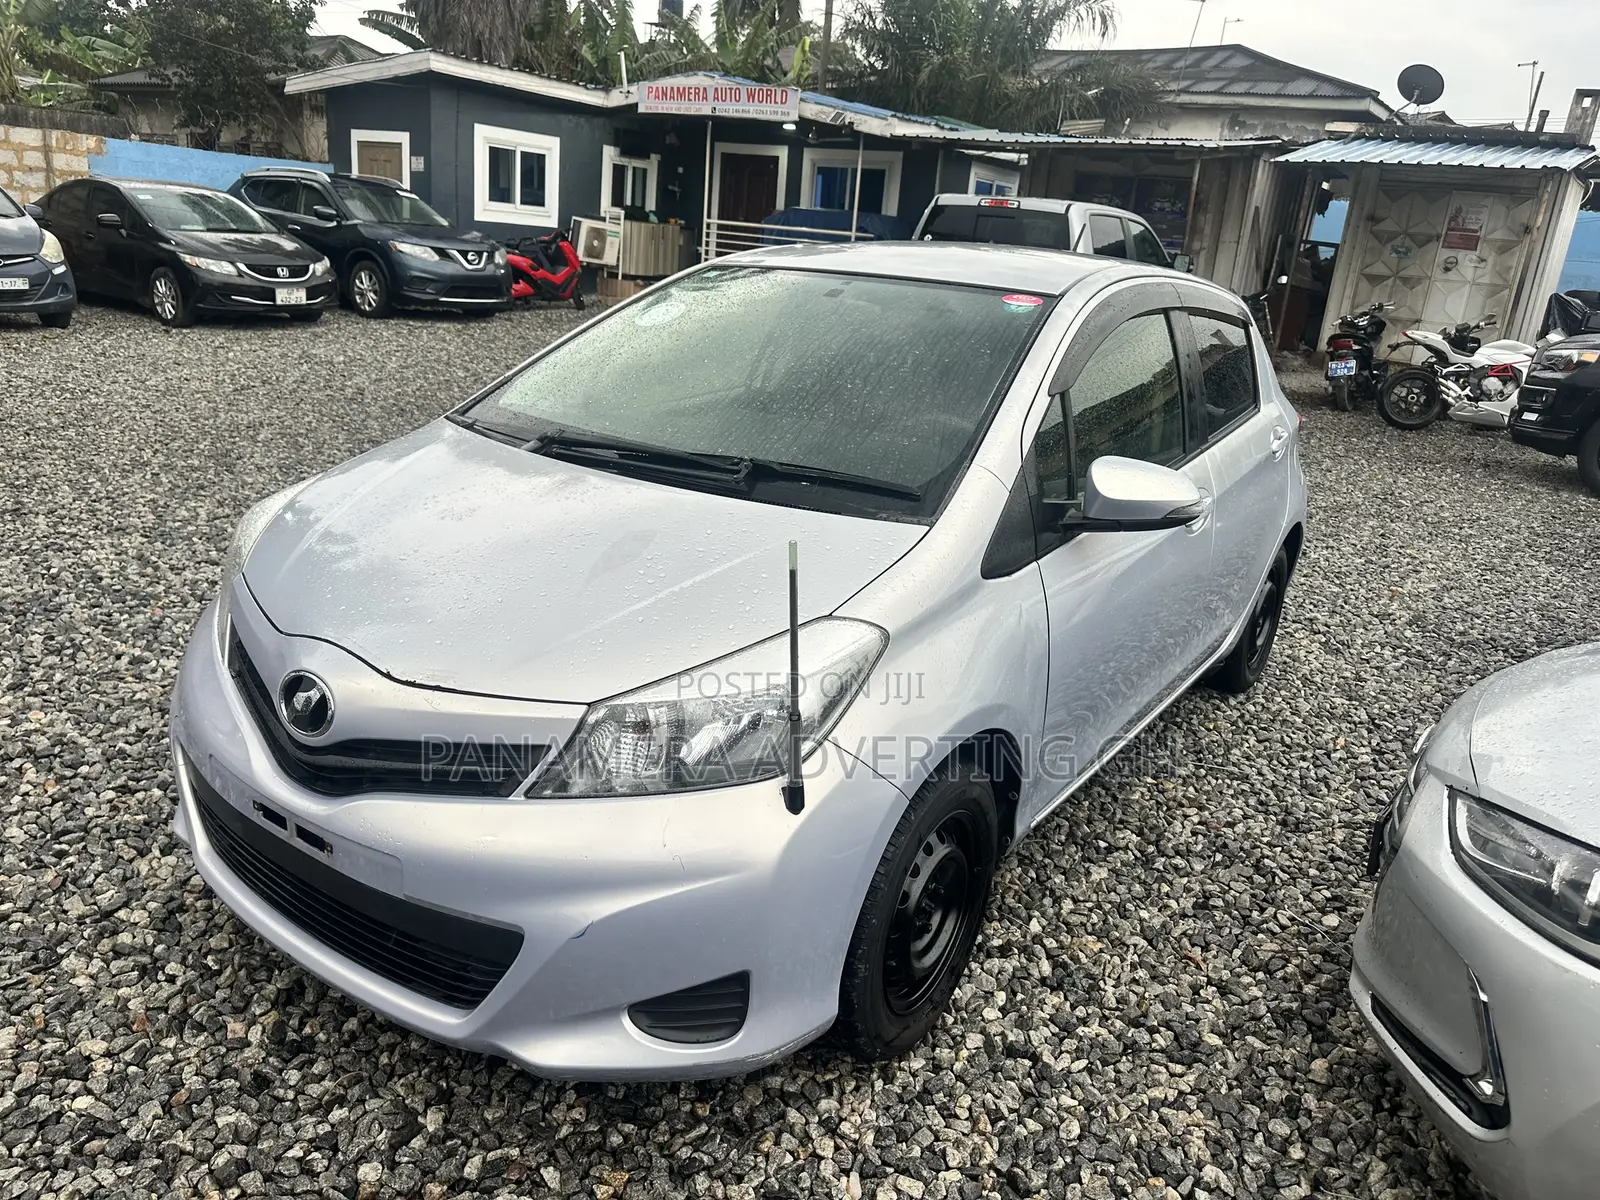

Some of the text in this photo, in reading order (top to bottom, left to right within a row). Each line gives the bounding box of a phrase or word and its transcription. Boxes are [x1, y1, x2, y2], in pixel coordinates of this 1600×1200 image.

[647, 86, 788, 105] PANAMERA AUTO WORLD
